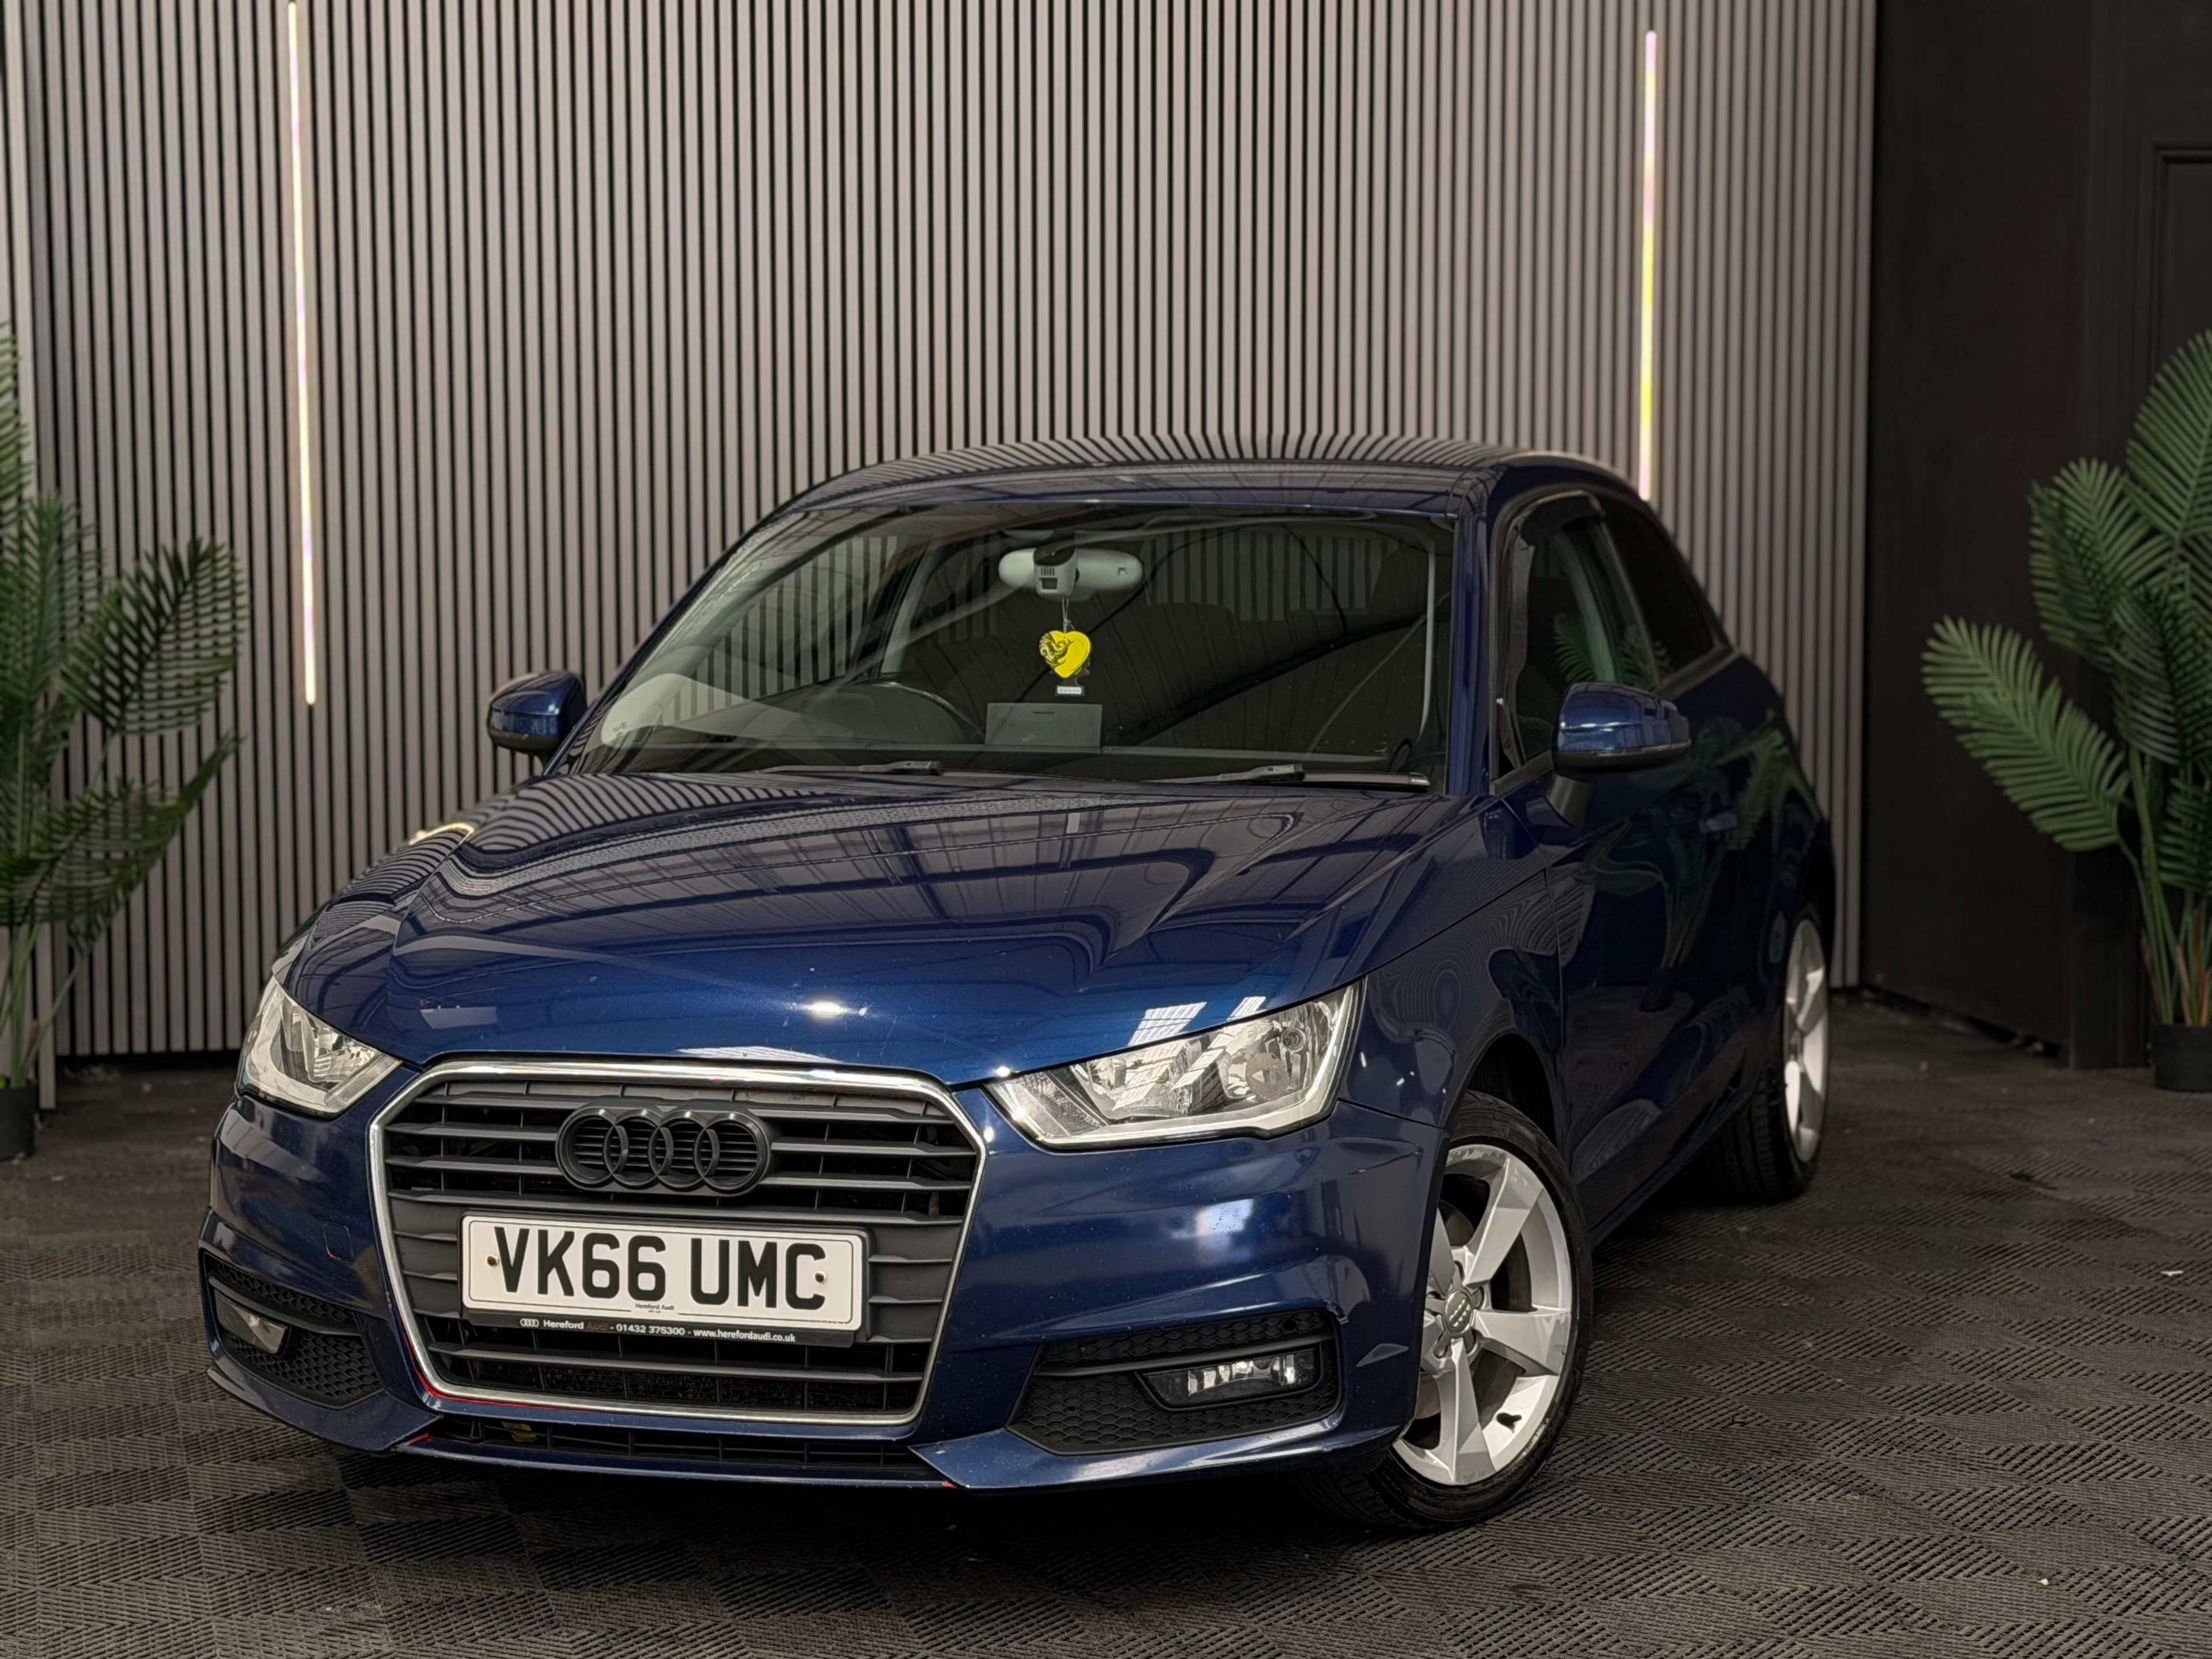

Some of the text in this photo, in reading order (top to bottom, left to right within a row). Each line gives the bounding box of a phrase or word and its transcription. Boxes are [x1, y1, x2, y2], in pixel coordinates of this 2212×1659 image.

[494, 1226, 827, 1310] VK66 UMC
[543, 1319, 584, 1330] Hereford
[616, 1323, 646, 1334] 01432
[648, 1325, 685, 1336] 375300
[693, 1329, 796, 1343] www.herefordaudi.co.uk
